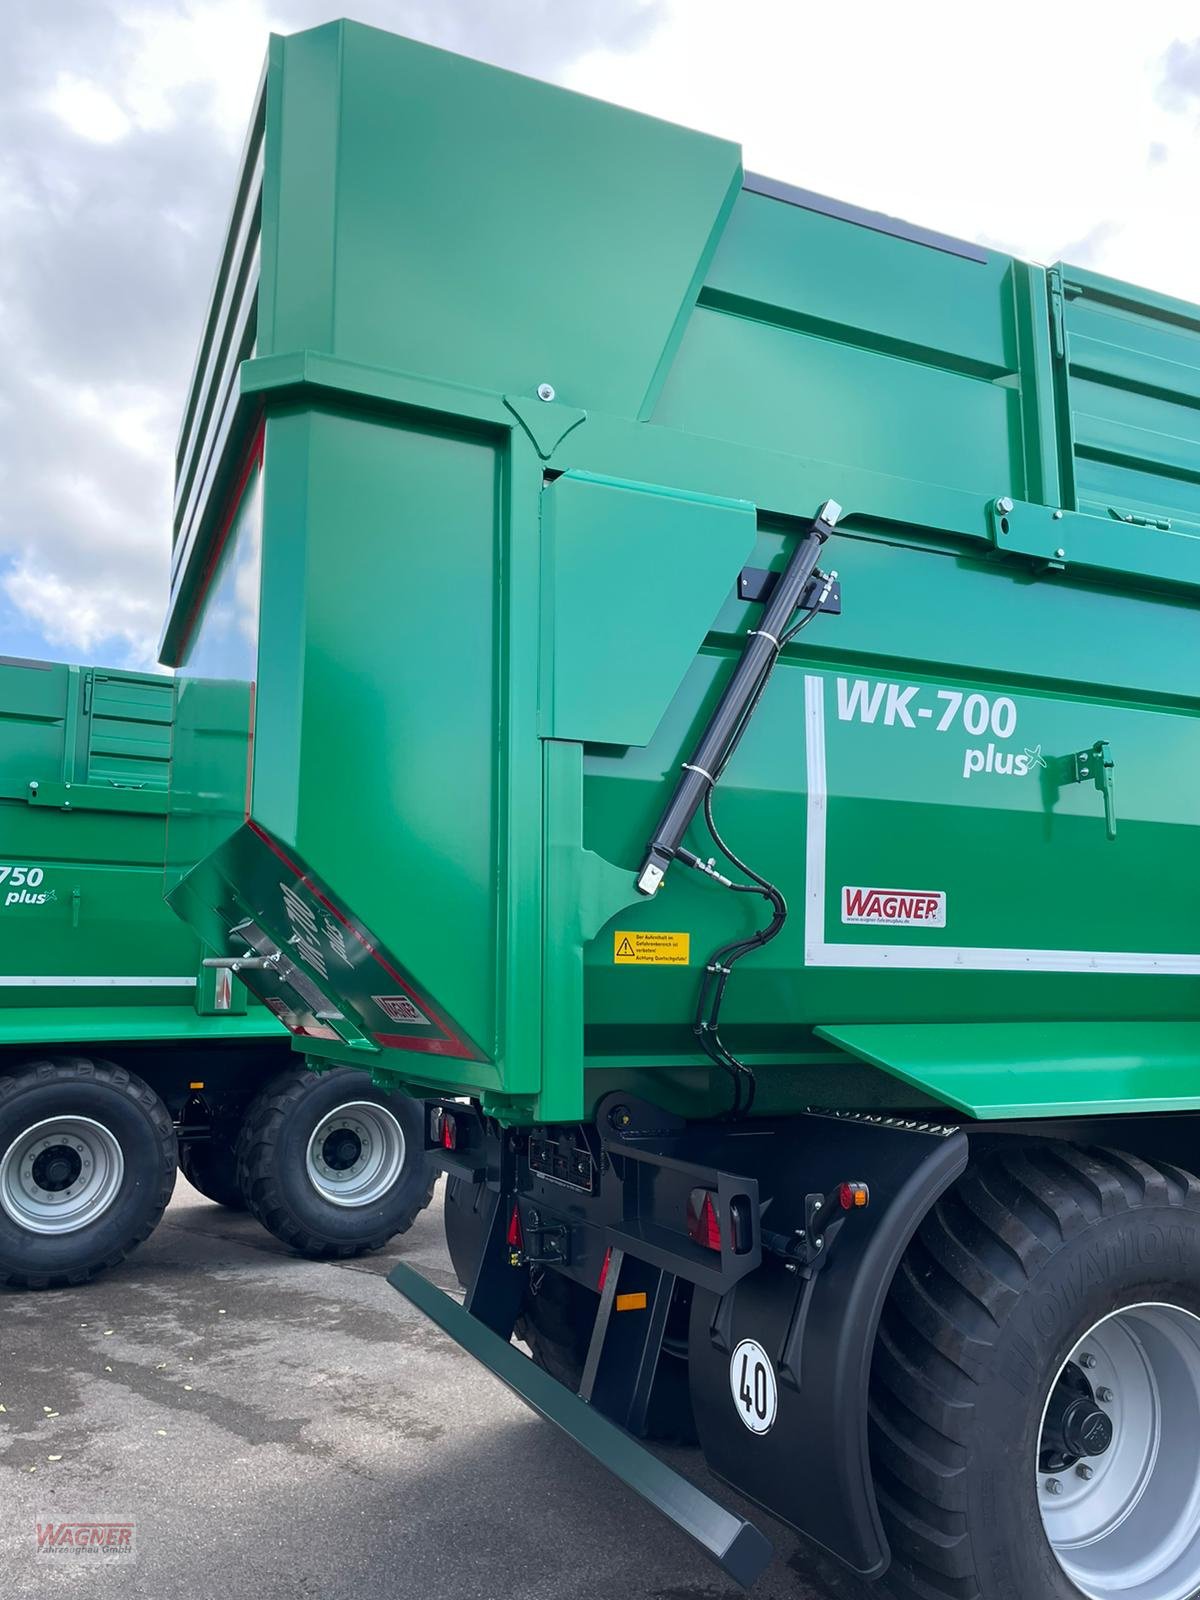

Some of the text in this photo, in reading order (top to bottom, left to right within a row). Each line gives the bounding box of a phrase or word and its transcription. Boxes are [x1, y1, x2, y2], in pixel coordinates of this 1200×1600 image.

[836, 676, 1018, 739] WK-700
[962, 743, 1030, 779] plus
[4, 889, 47, 906] plus
[845, 888, 942, 920] WAGNER
[739, 1353, 768, 1421] 40
